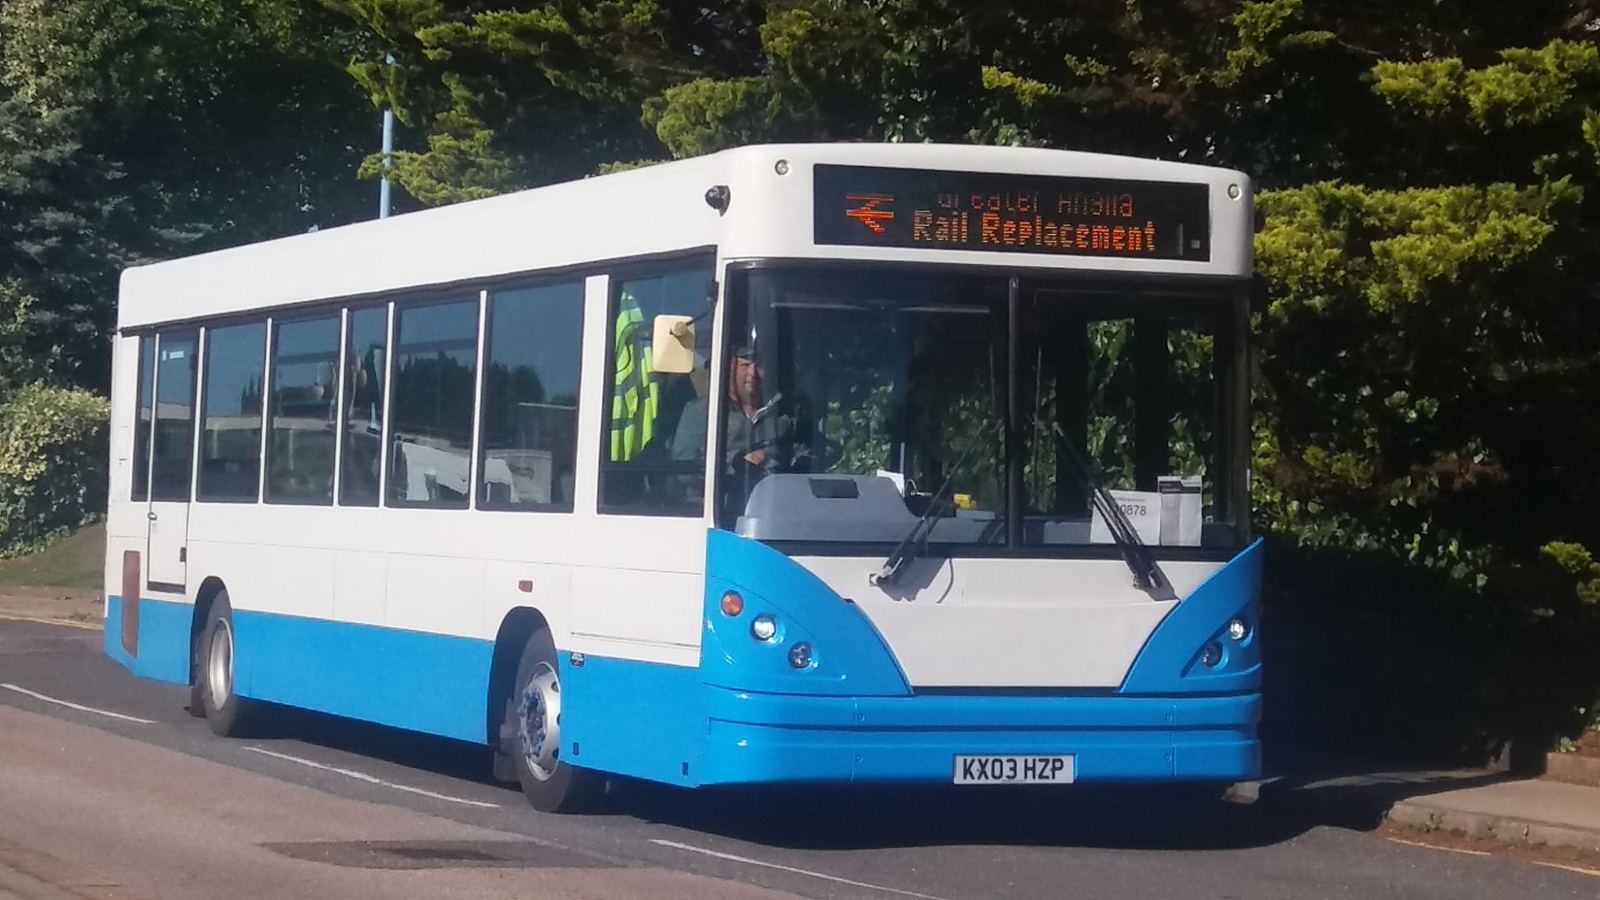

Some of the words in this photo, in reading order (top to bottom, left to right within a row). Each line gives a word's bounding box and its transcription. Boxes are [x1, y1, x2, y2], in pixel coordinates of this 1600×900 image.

[914, 208, 968, 242] Rail
[982, 211, 1156, 251] Replacement
[963, 758, 1017, 780] KX03
[1024, 758, 1064, 780] HZP
